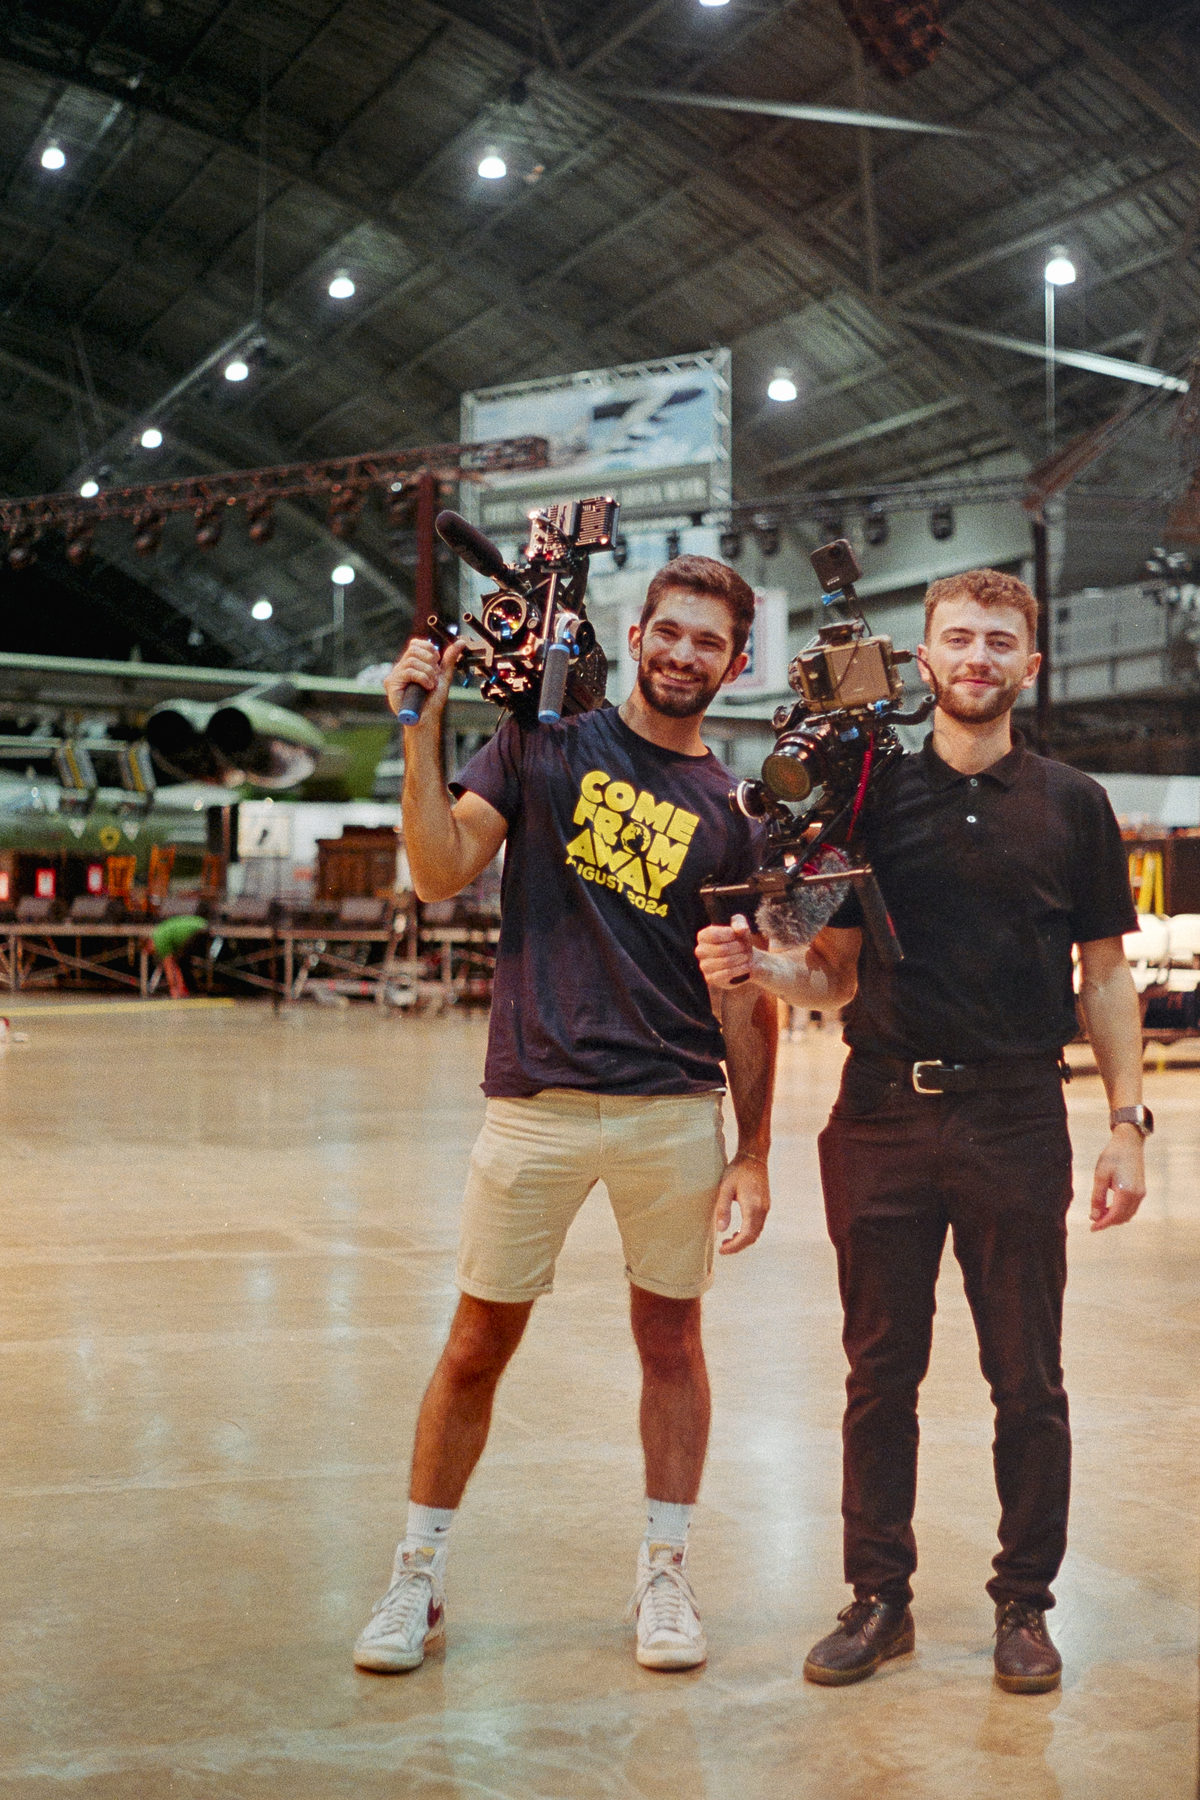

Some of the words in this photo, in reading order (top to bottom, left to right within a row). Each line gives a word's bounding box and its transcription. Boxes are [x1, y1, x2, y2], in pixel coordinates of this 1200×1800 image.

[573, 794, 689, 875] FROM
[581, 770, 700, 845] COME
[566, 828, 678, 900] AWAY
[626, 891, 669, 918] 2024
